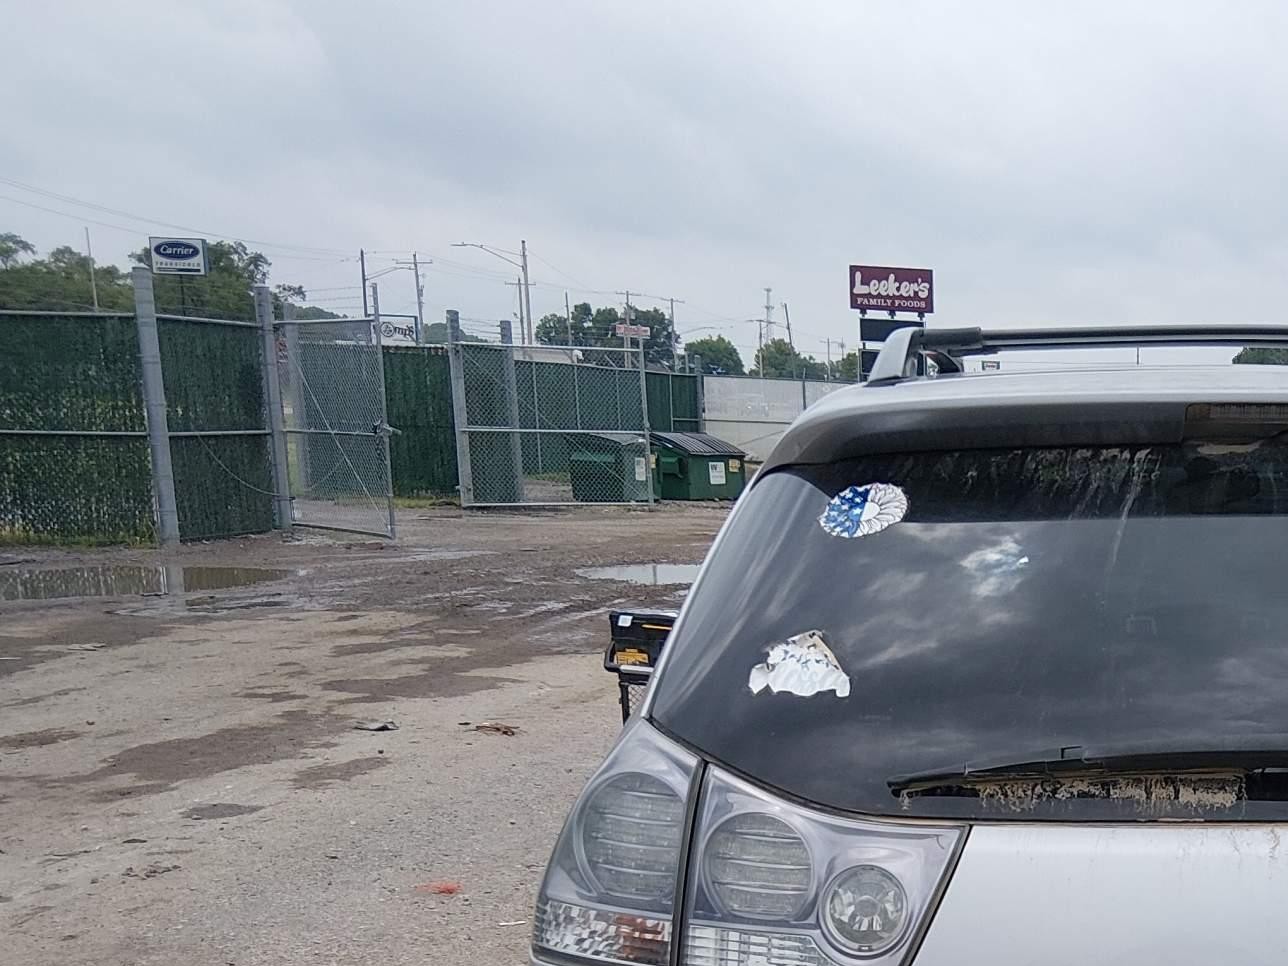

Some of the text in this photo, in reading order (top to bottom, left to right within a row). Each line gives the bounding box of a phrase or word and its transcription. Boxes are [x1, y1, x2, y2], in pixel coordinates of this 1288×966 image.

[160, 244, 194, 254] Carrier
[853, 271, 930, 298] Leeker's
[857, 298, 926, 308] FAMILY FOODS
